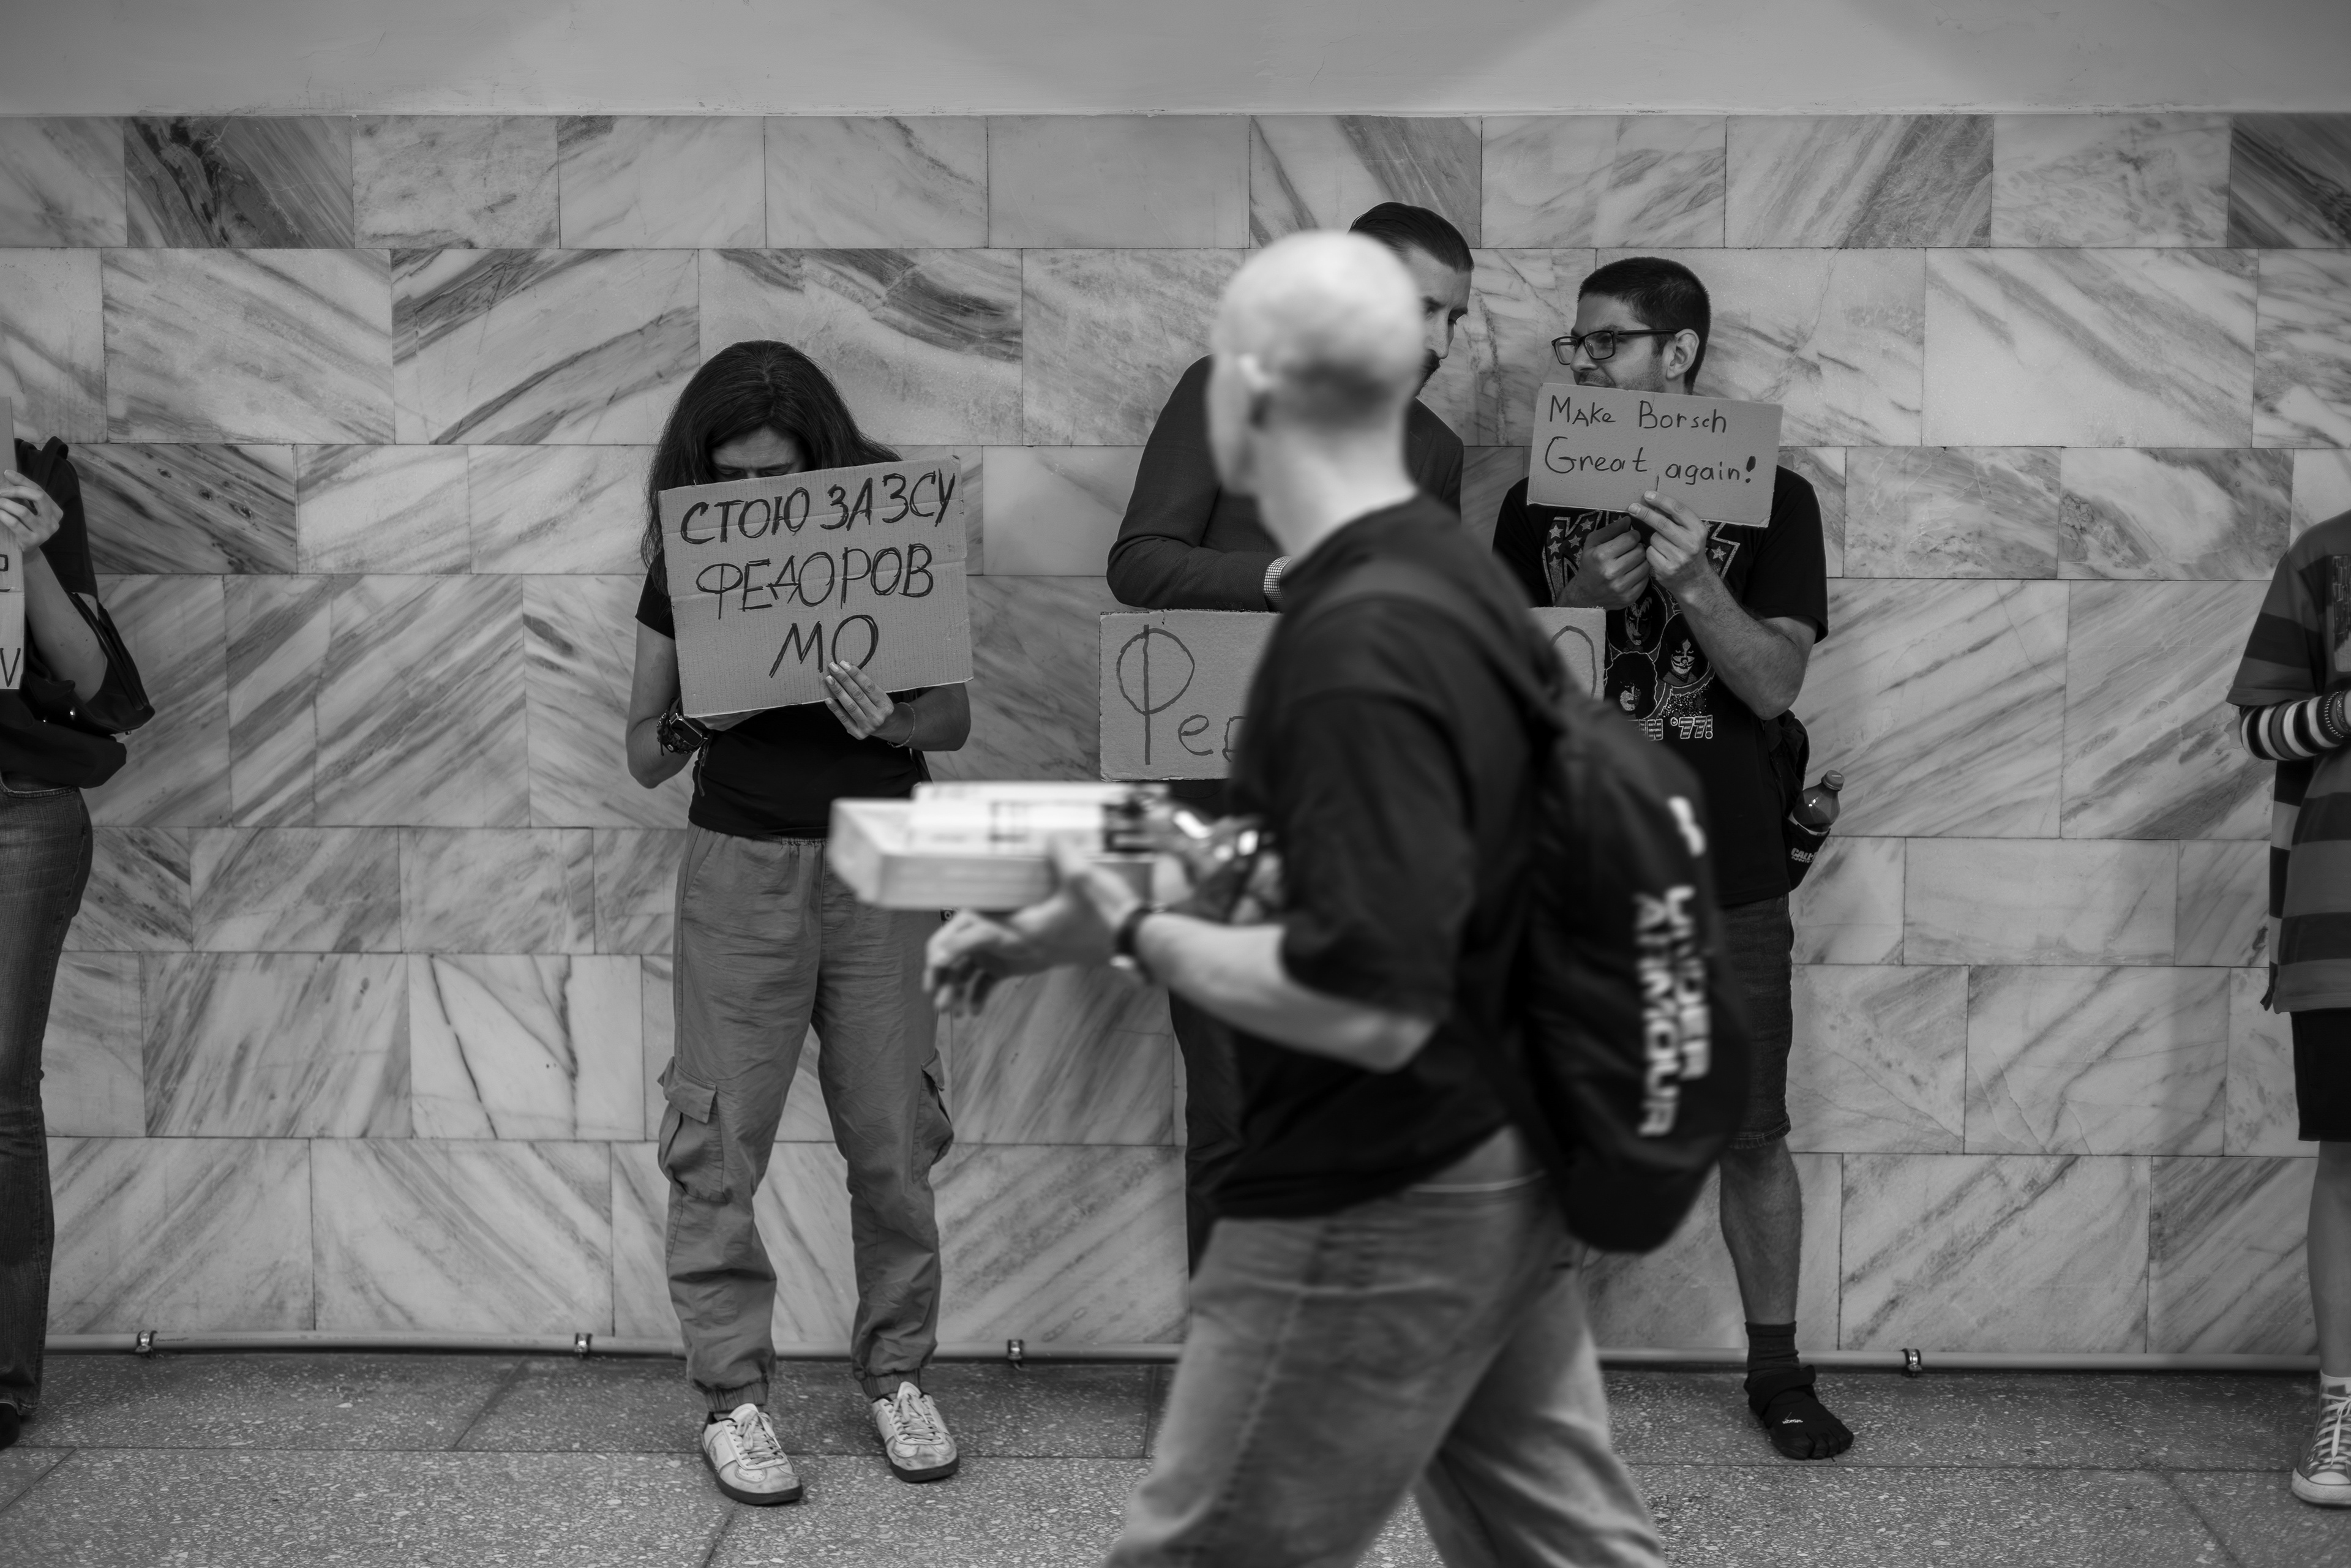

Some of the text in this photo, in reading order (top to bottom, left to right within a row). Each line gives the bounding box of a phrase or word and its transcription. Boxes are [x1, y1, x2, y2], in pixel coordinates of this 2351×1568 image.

[1638, 400, 1727, 433] Borsch
[1544, 435, 1756, 486] Great again!
[680, 487, 810, 544] СТОЮ
[696, 542, 934, 620] ФЕДОРОВ
[769, 614, 879, 678] МО
